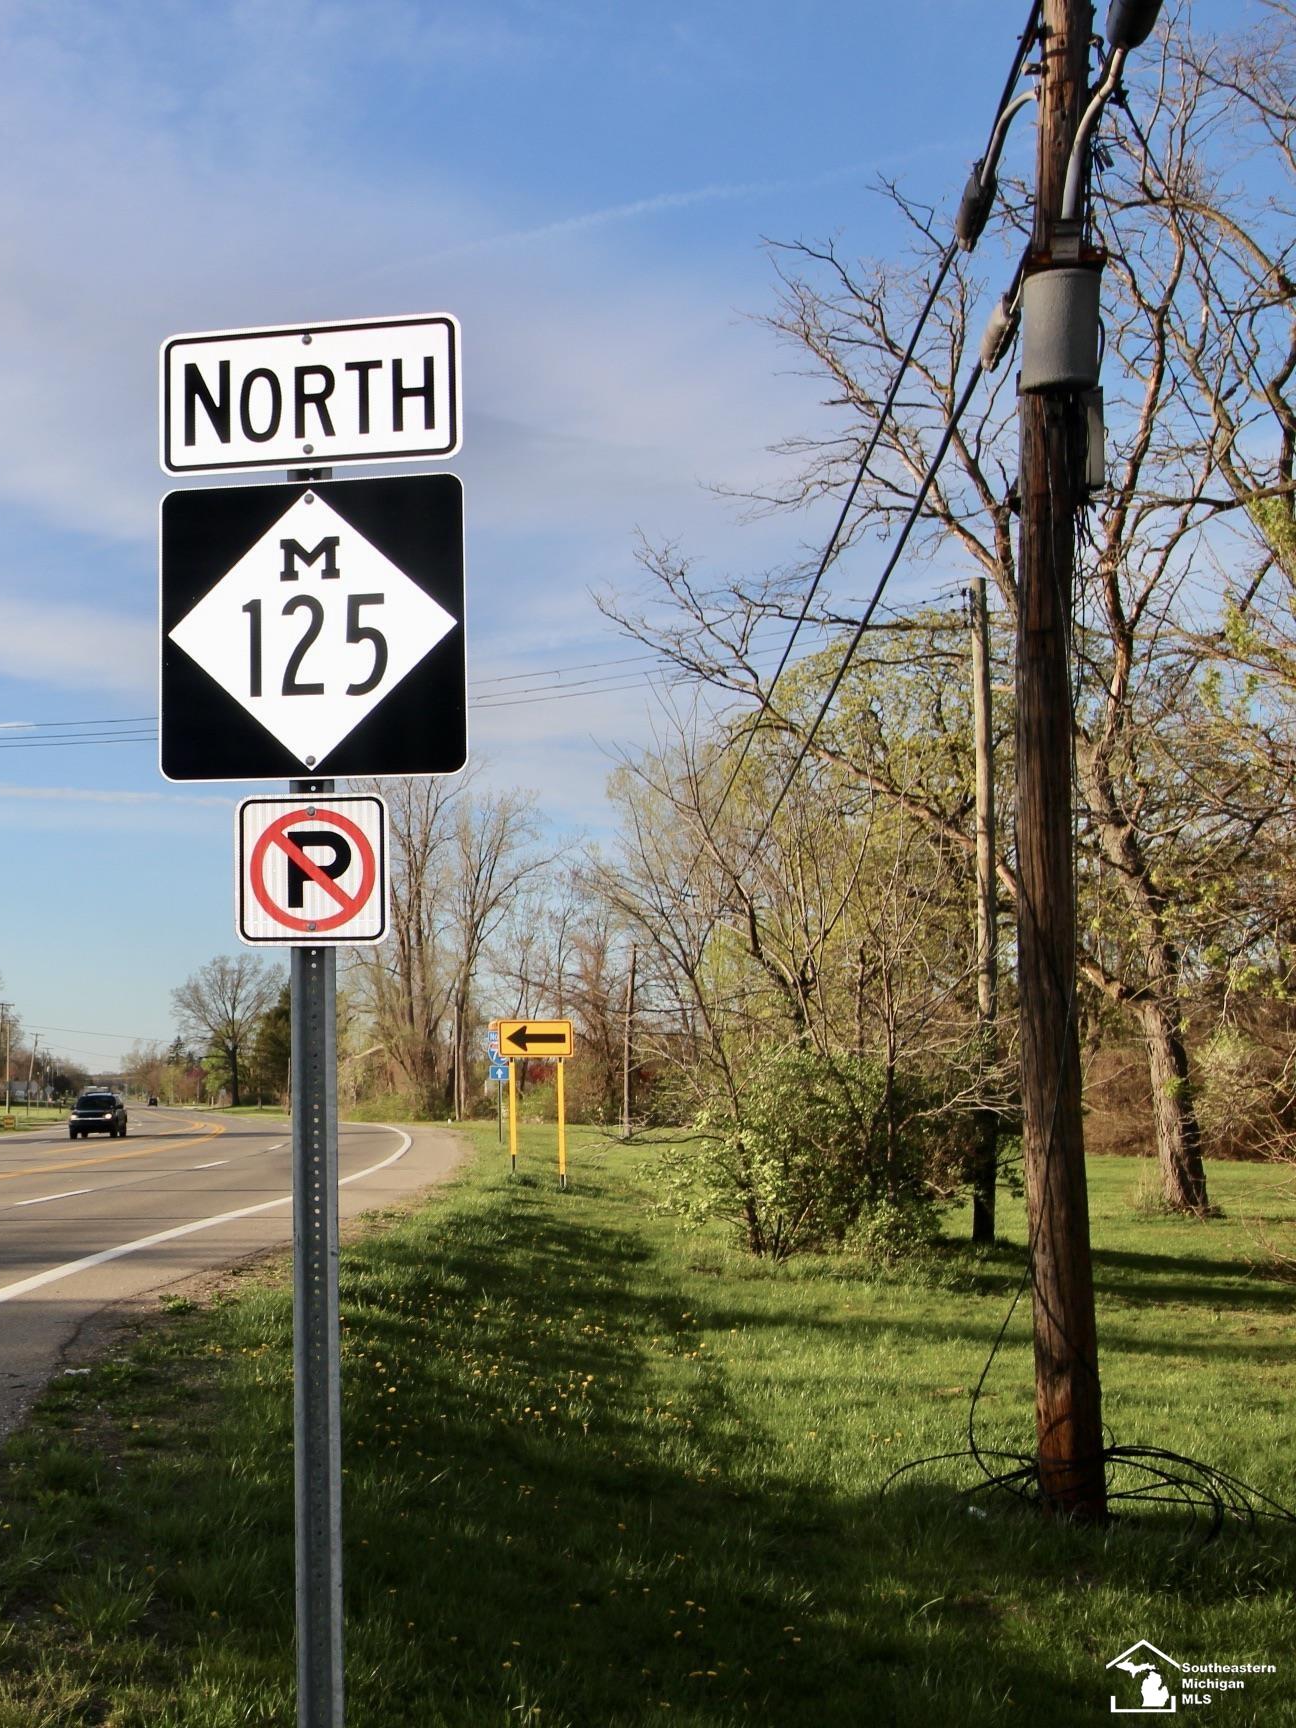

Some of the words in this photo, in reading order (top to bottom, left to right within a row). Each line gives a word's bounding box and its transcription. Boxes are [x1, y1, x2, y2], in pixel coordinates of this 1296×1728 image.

[184, 355, 435, 447] NORTH
[280, 536, 340, 581] M
[242, 593, 388, 698] 125
[287, 831, 352, 908] P
